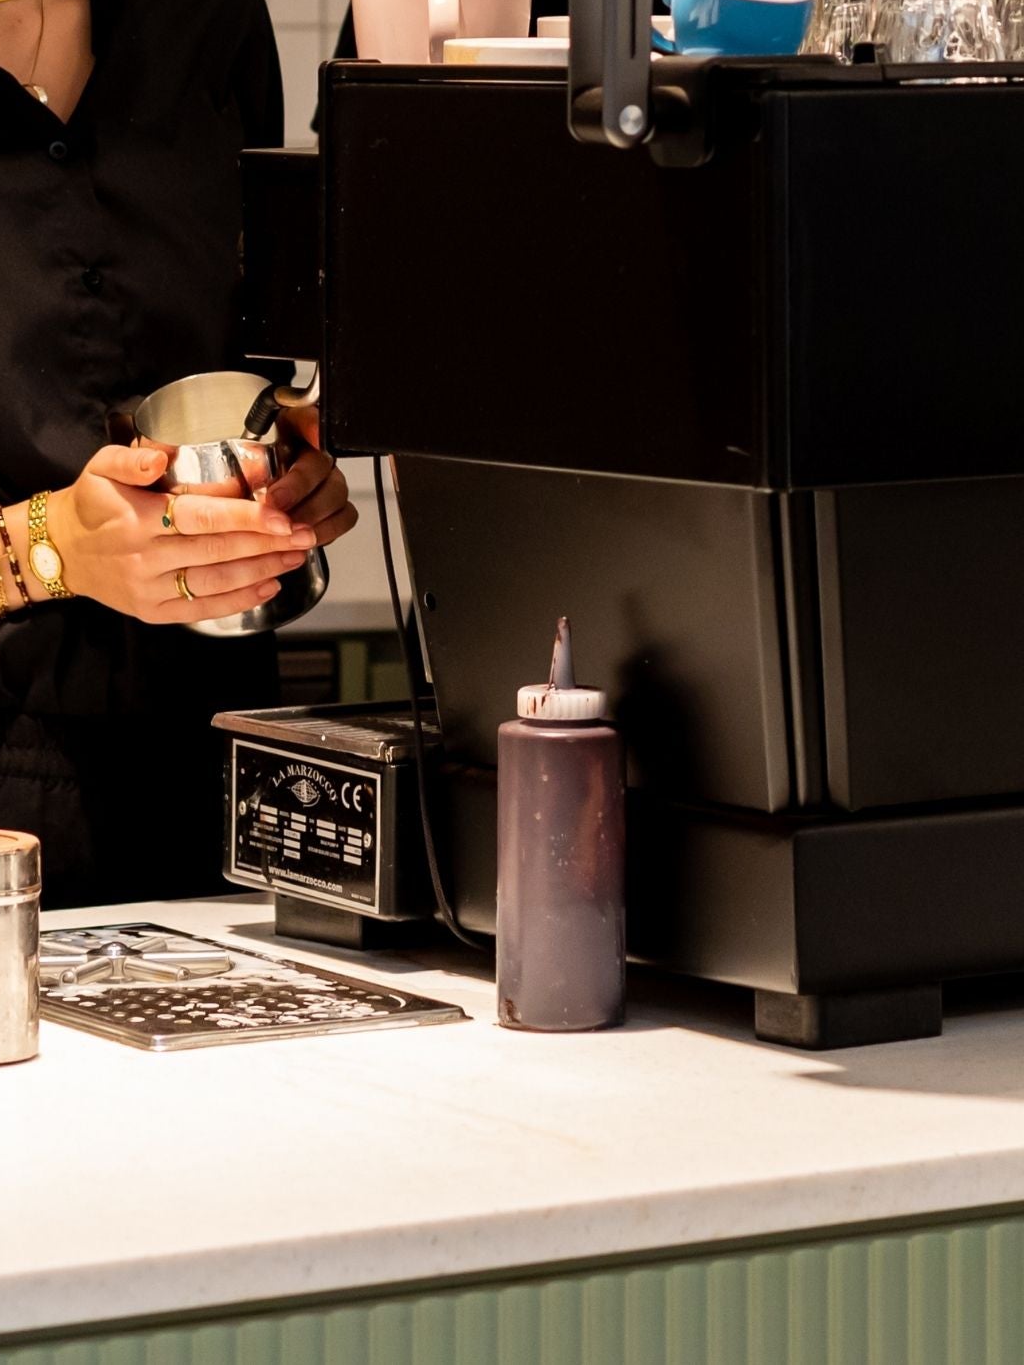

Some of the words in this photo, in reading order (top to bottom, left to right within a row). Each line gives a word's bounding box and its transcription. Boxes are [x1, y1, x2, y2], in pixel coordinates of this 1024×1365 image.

[272, 770, 286, 786] LA
[287, 764, 337, 801] MARZOCCO
[341, 782, 362, 812] CE
[268, 866, 343, 893] www.lamarzocco.com
